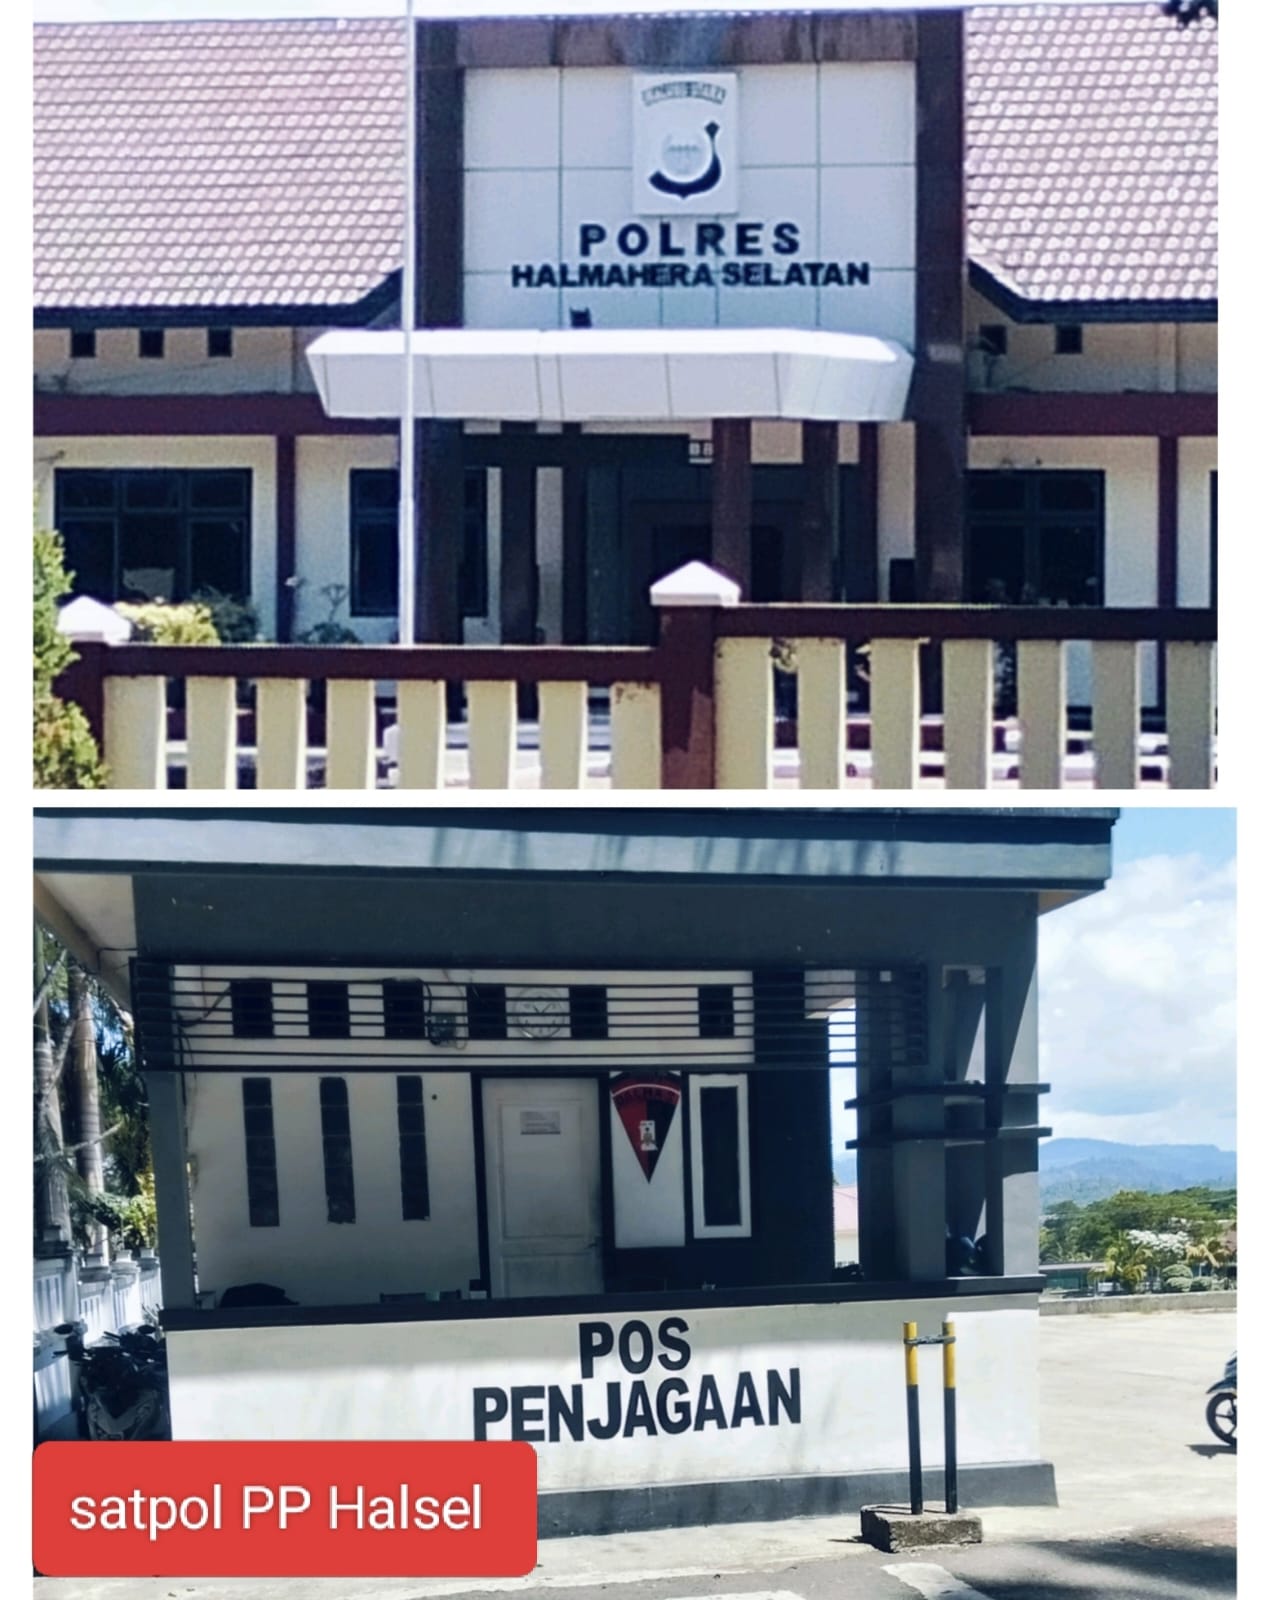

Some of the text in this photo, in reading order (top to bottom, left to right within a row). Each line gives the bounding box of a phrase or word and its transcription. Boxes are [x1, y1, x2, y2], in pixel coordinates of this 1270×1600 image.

[580, 222, 800, 257] POLRES
[511, 262, 870, 288] HALMAHERA SELATAN
[579, 1317, 691, 1379] POS
[473, 1367, 801, 1443] PENJAGAAN
